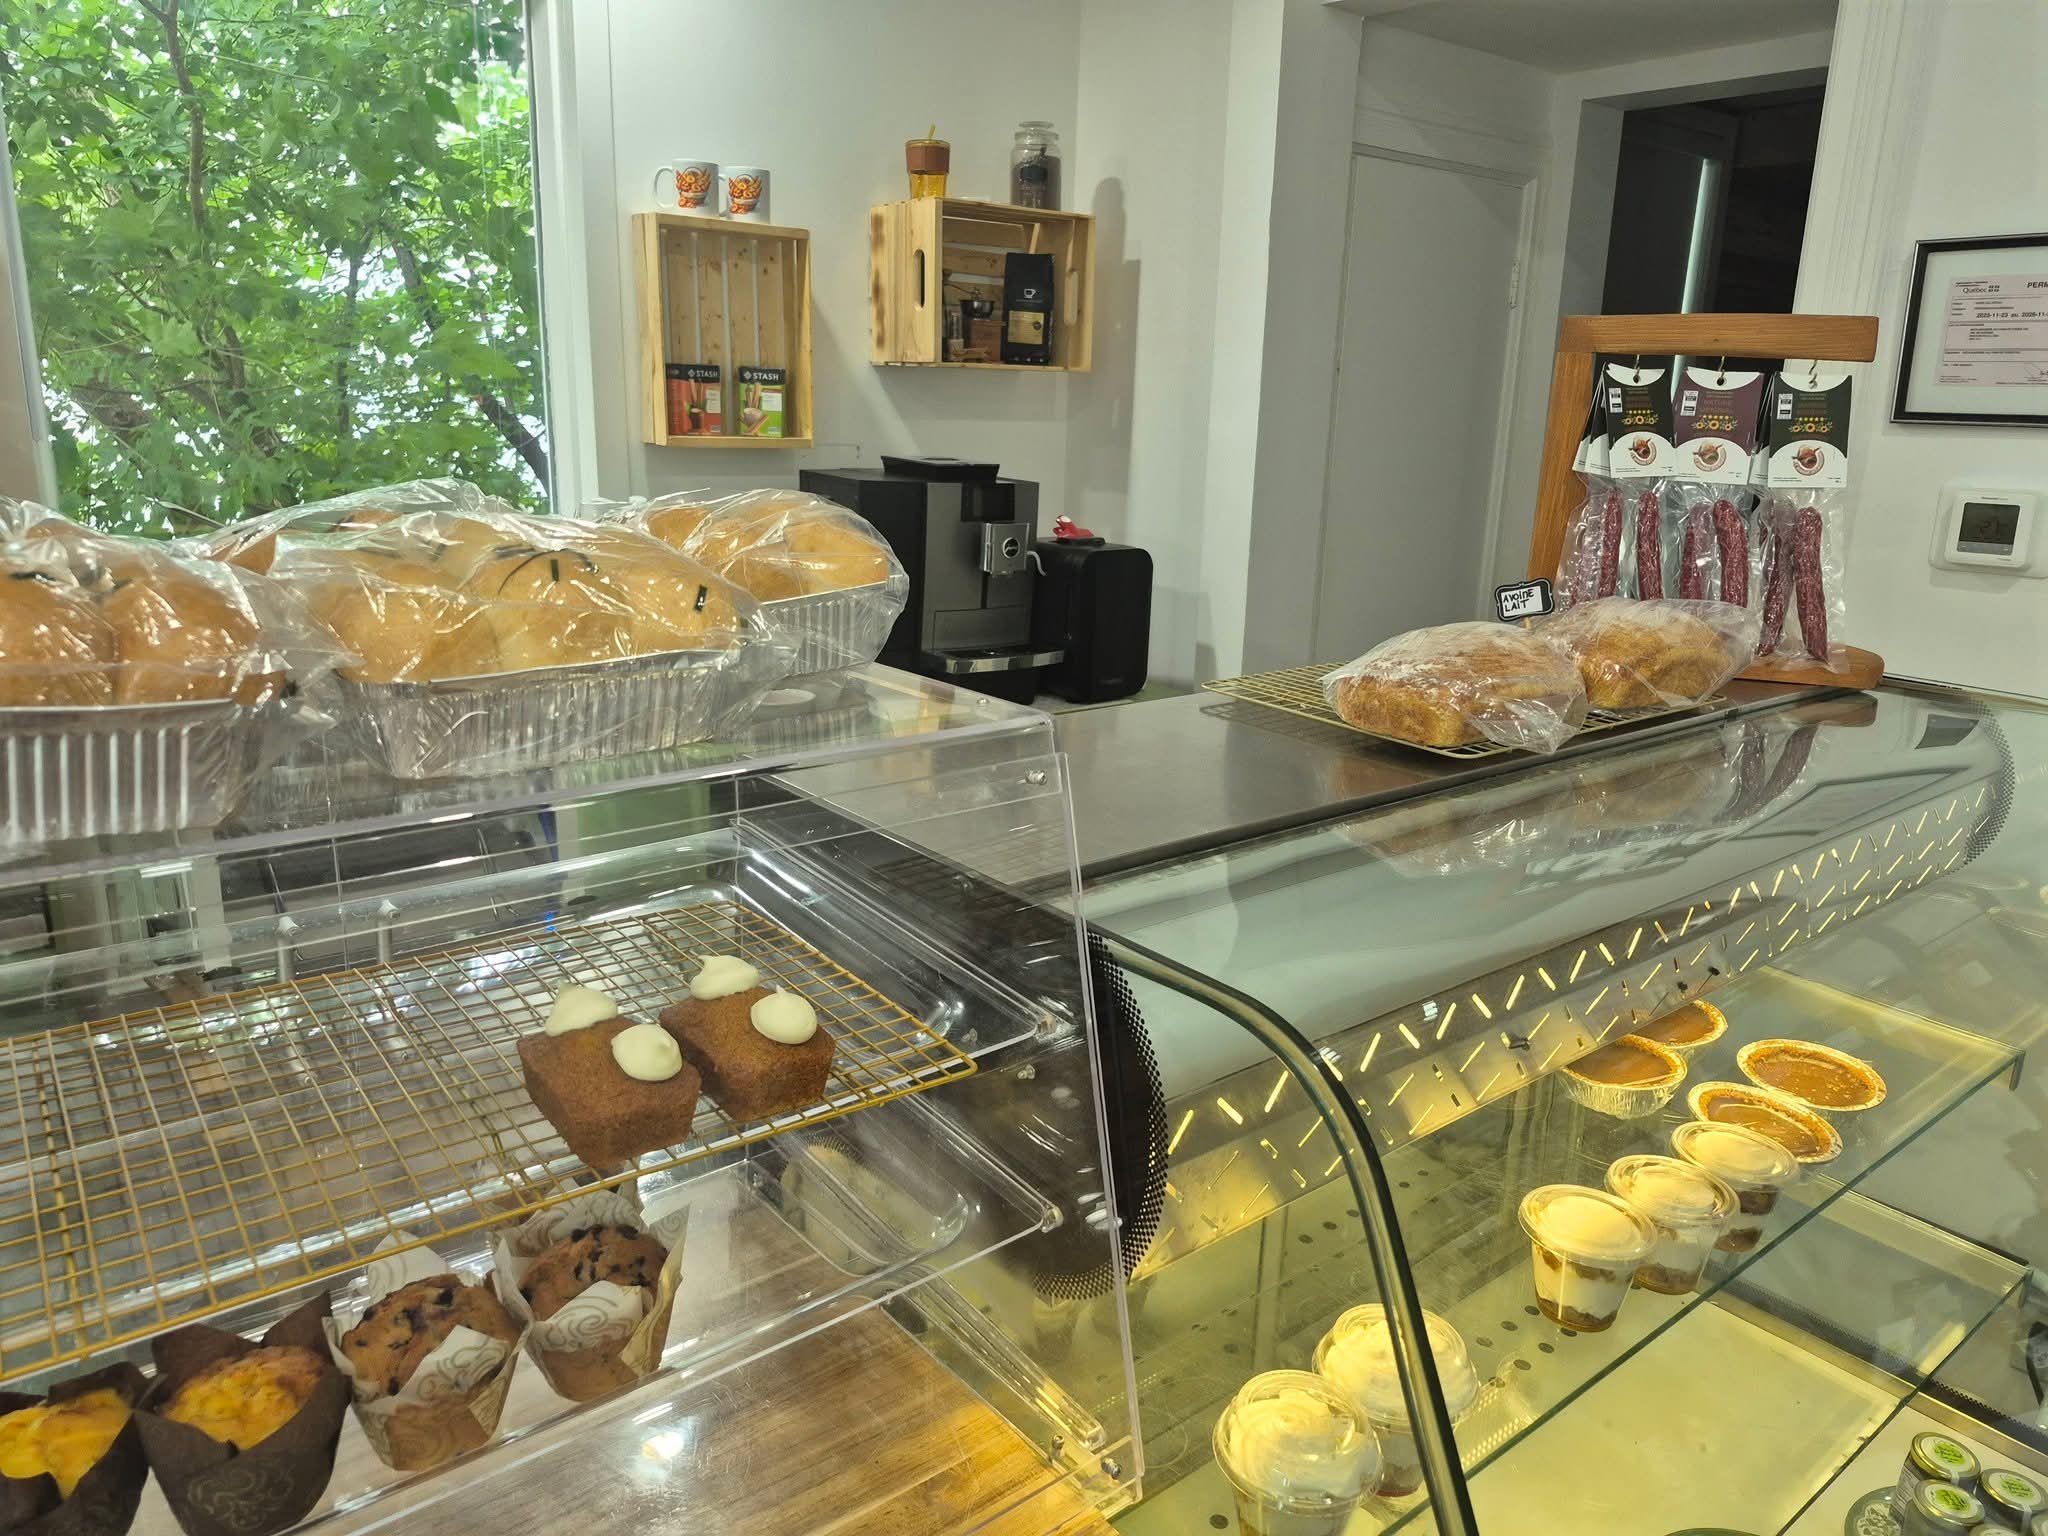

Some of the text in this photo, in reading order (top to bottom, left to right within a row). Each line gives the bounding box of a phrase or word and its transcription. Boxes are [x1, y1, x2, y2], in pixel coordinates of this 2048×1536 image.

[696, 370, 718, 378] STASH
[752, 372, 779, 381] STASH
[1504, 598, 1530, 612] LAIT
